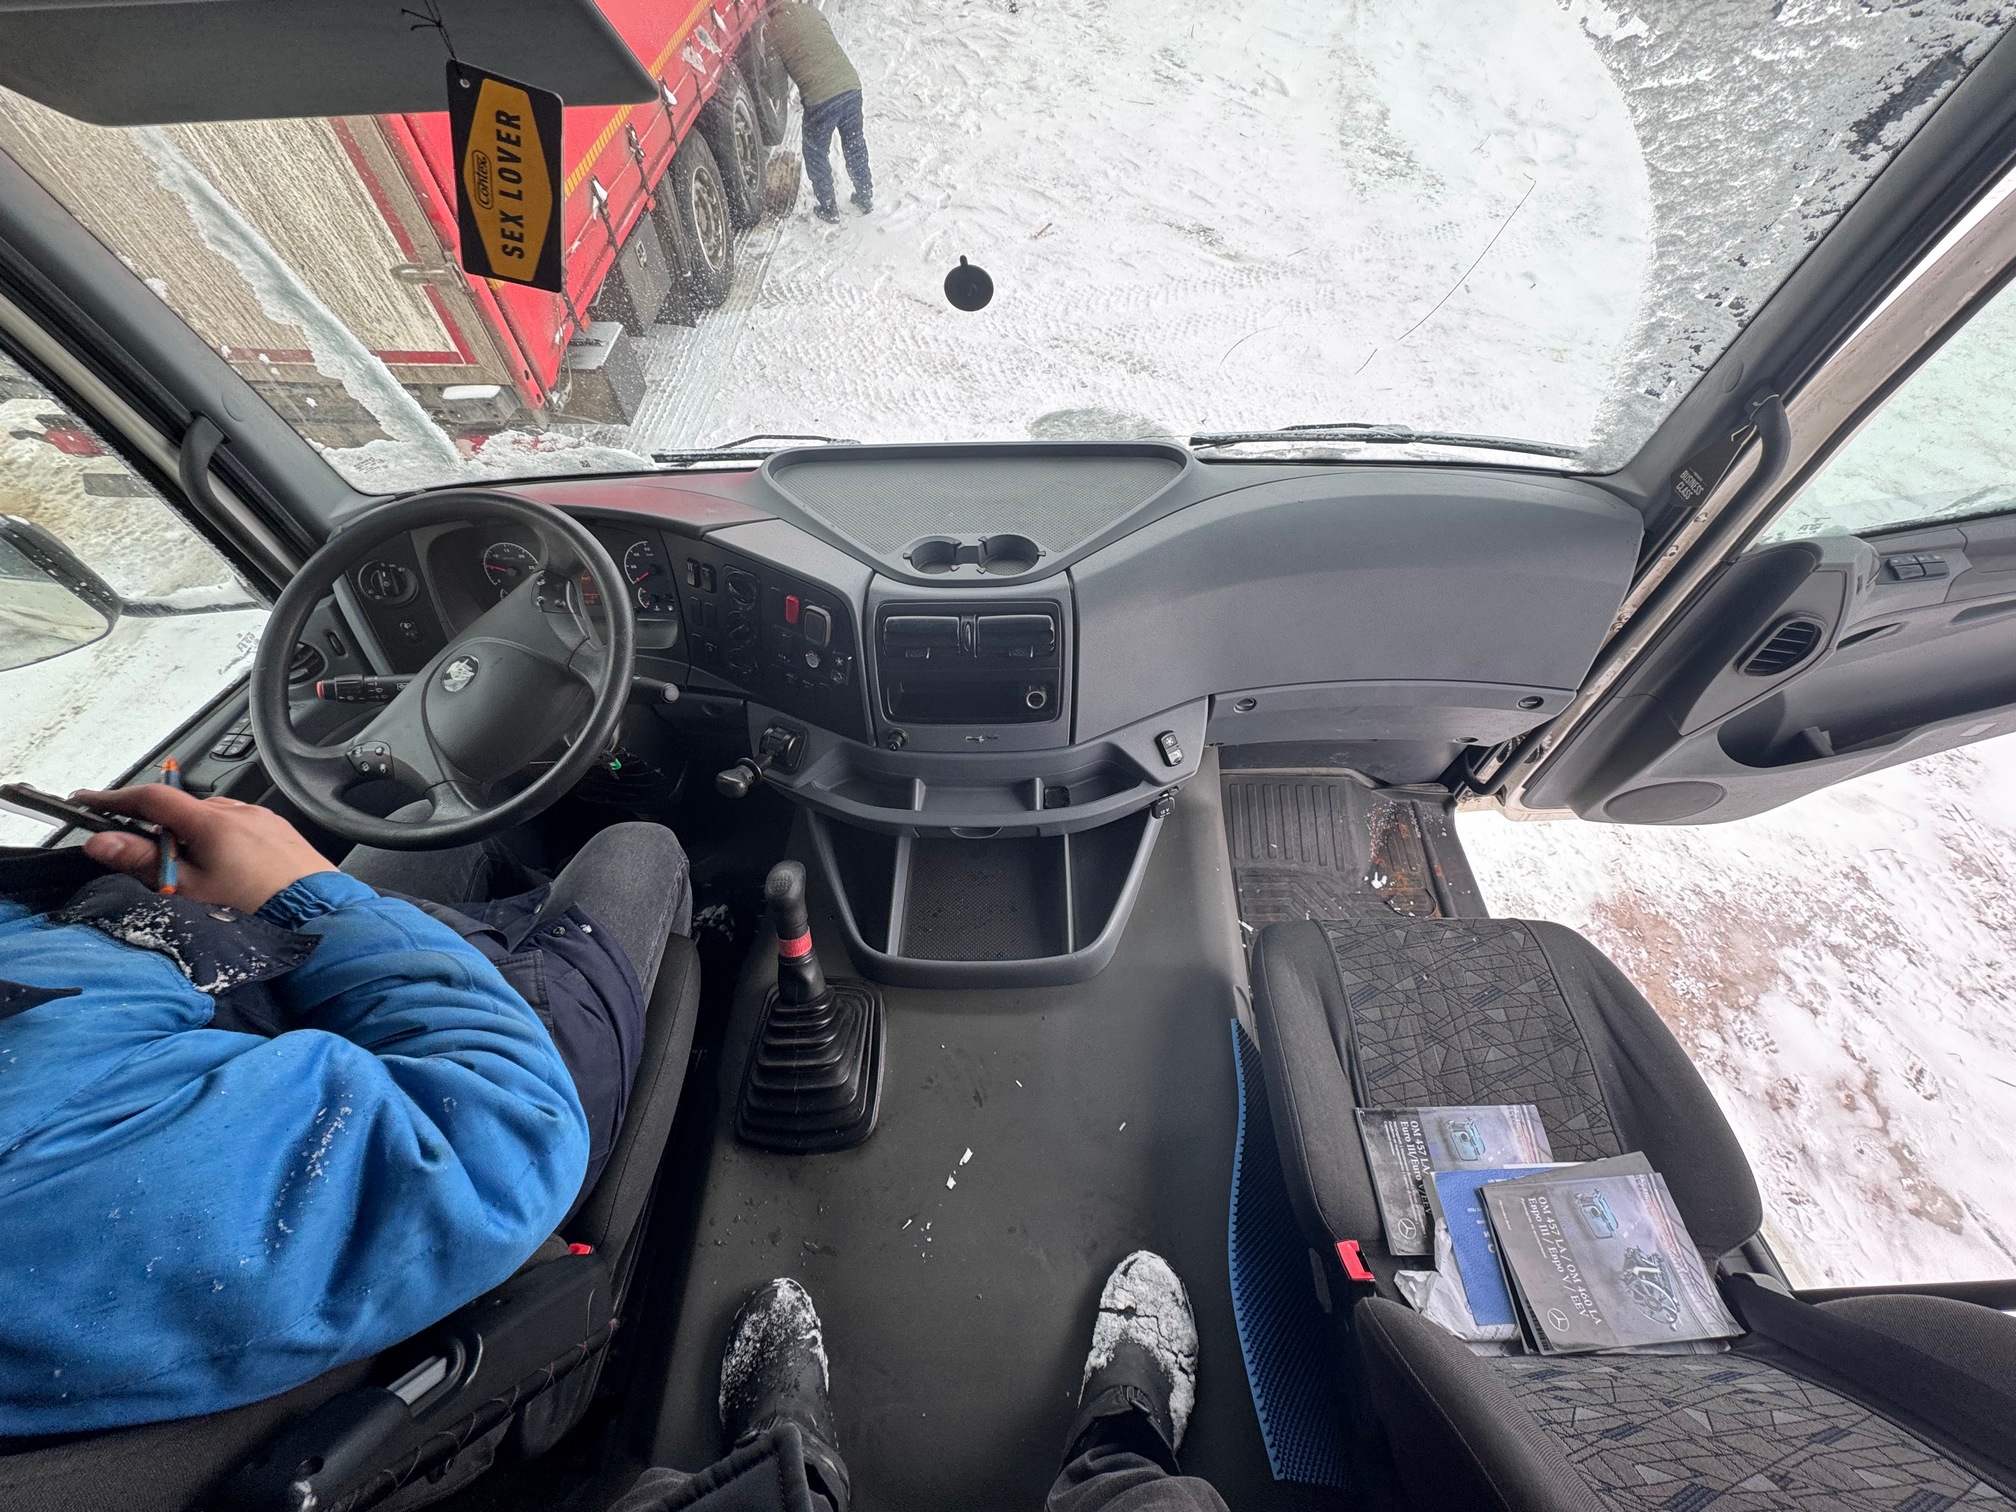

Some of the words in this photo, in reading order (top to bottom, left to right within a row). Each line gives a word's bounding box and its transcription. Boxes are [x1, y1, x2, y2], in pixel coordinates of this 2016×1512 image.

[495, 109, 523, 201] LOVER
[499, 209, 525, 260] SEX
[1676, 481, 1693, 500] CLASS
[1680, 470, 1704, 495] BUSINESS
[1400, 1121, 1412, 1142] Euro
[1407, 1144, 1422, 1180] III/Euro
[1410, 1120, 1422, 1137] OM
[1415, 1139, 1427, 1155] 457
[1528, 1197, 1542, 1222] Евро
[1538, 1224, 1550, 1236] III
[1548, 1247, 1564, 1273] Евро
[1562, 1275, 1573, 1284] V
[1570, 1295, 1589, 1318] EEV
[1538, 1196, 1552, 1214] OM
[1546, 1216, 1560, 1236] 457
[1555, 1238, 1567, 1254] LA
[1566, 1264, 1582, 1283] OM
[1578, 1286, 1593, 1306] 460
[1589, 1309, 1602, 1325] LA
